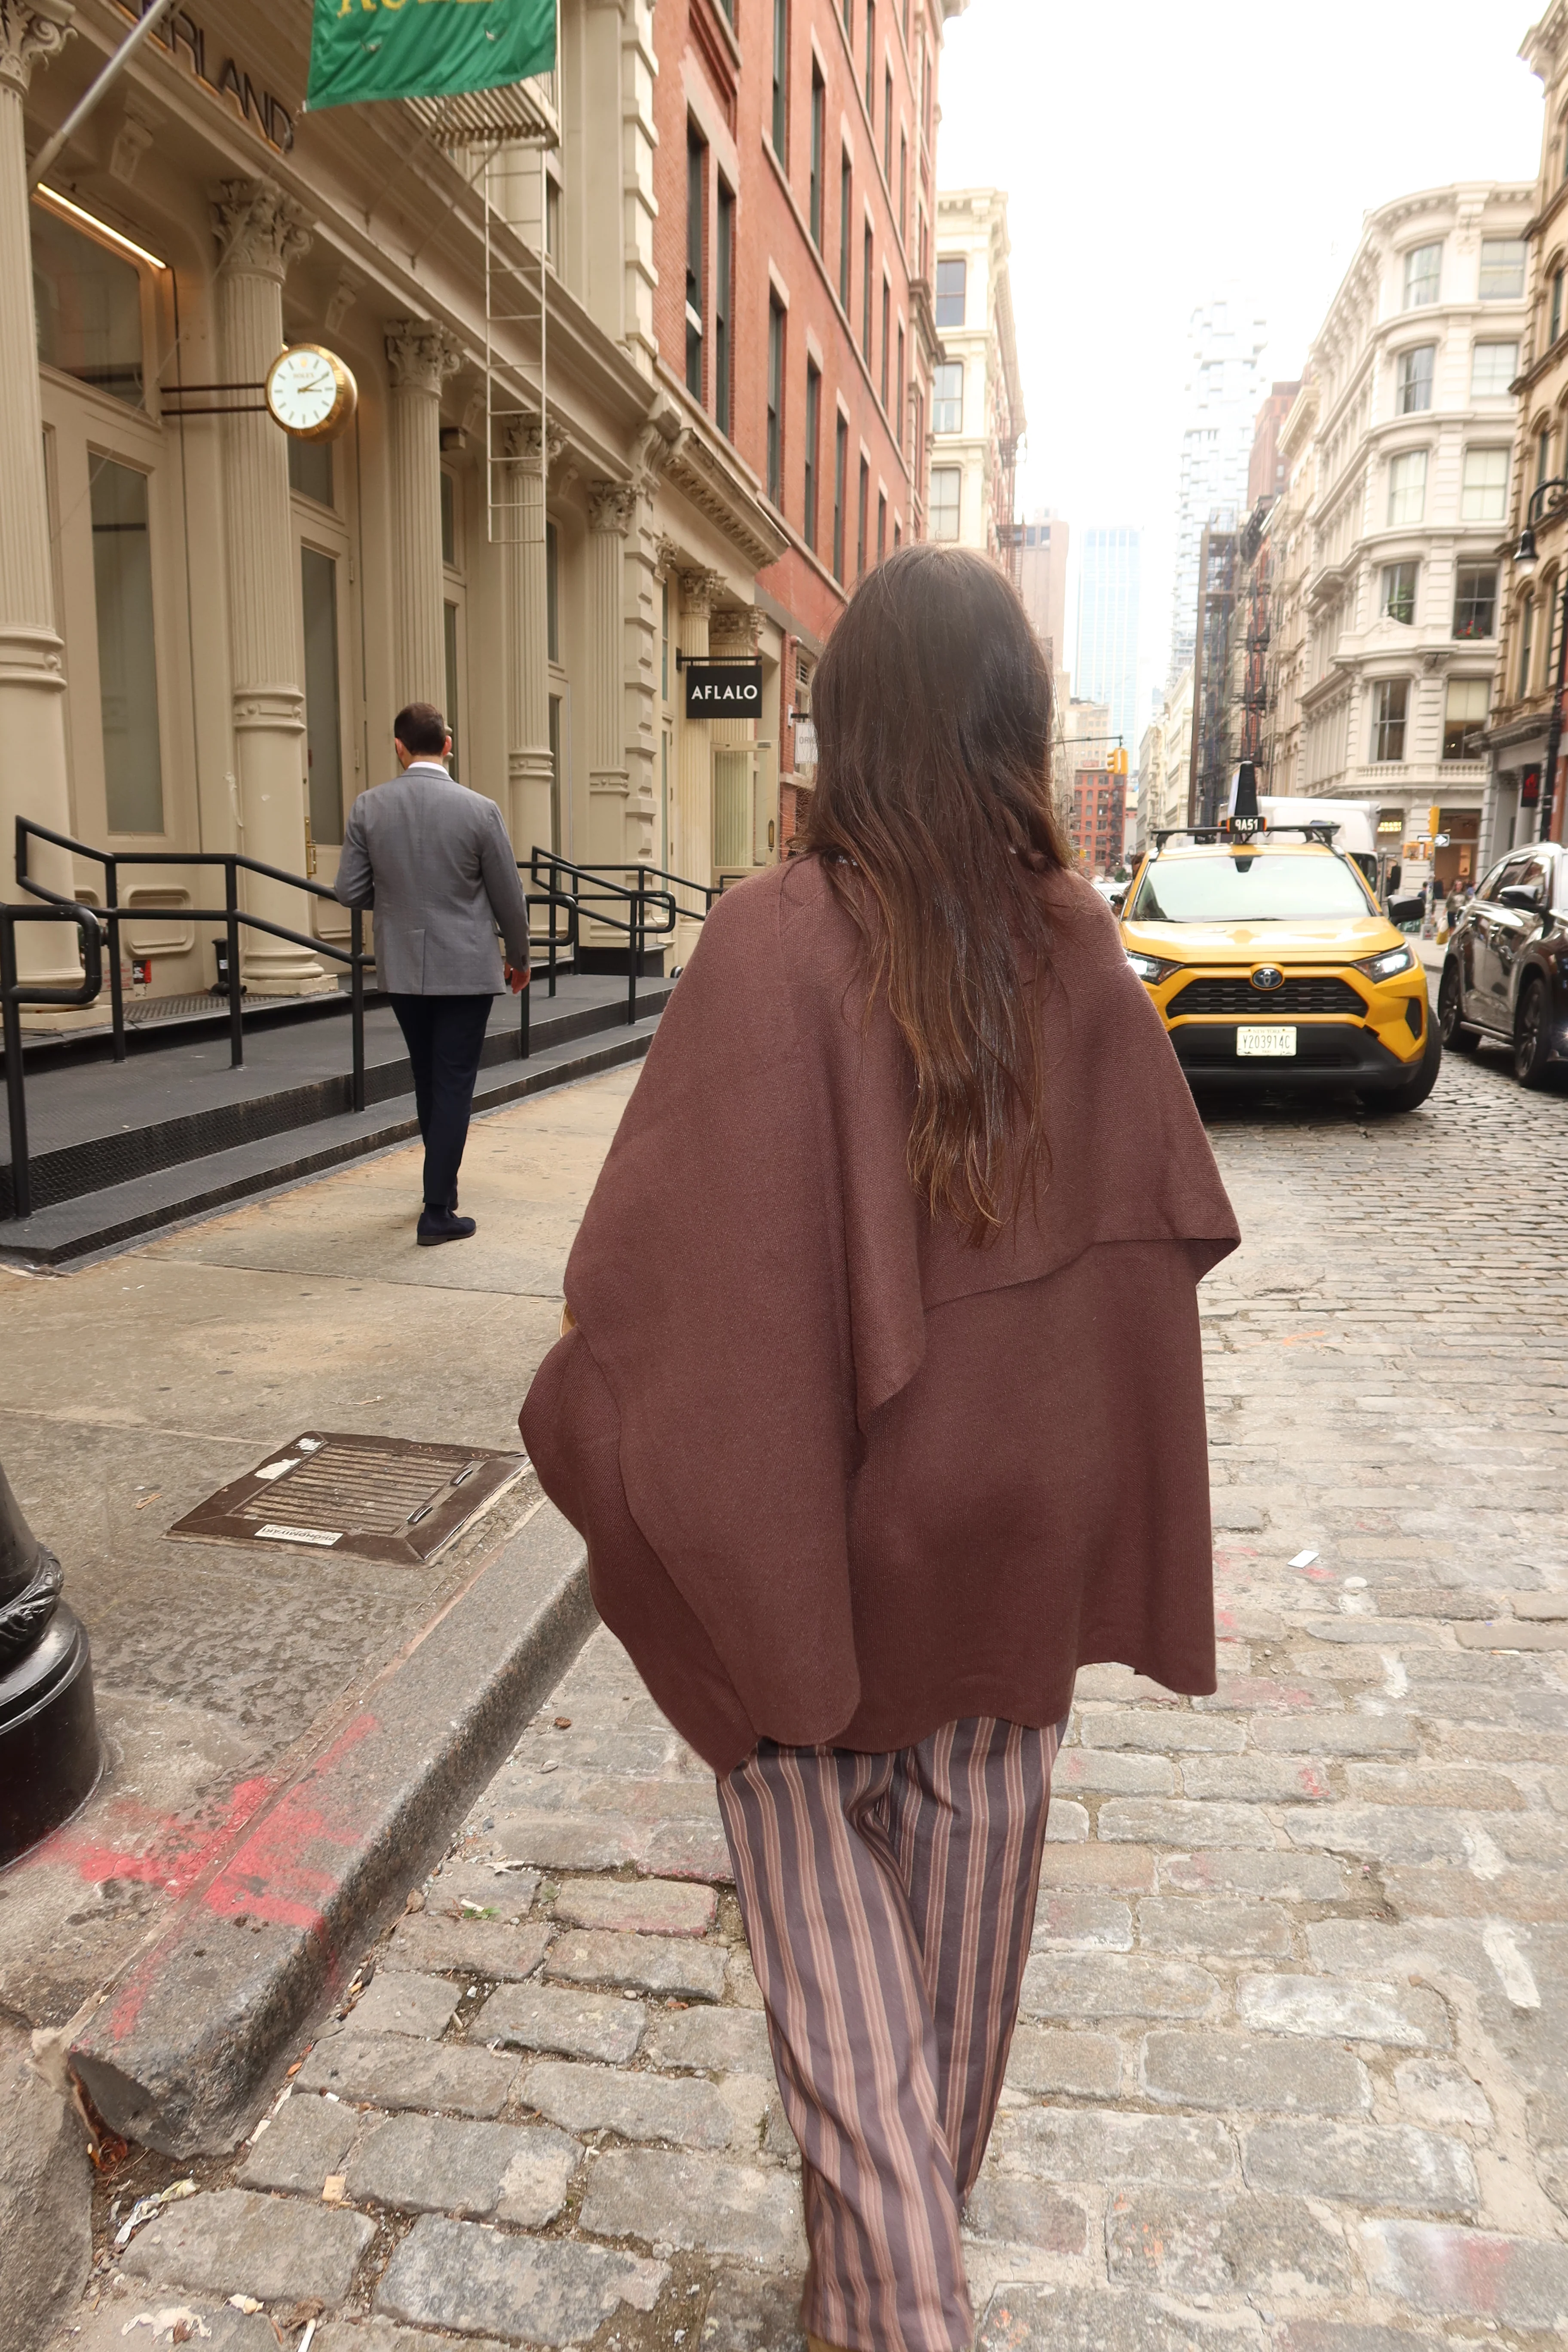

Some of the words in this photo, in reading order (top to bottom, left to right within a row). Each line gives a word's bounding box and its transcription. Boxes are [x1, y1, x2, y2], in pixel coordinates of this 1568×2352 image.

[691, 685, 758, 700] AFLALO
[1234, 818, 1259, 831] 9A51
[1243, 1035, 1290, 1049] Y203914C
